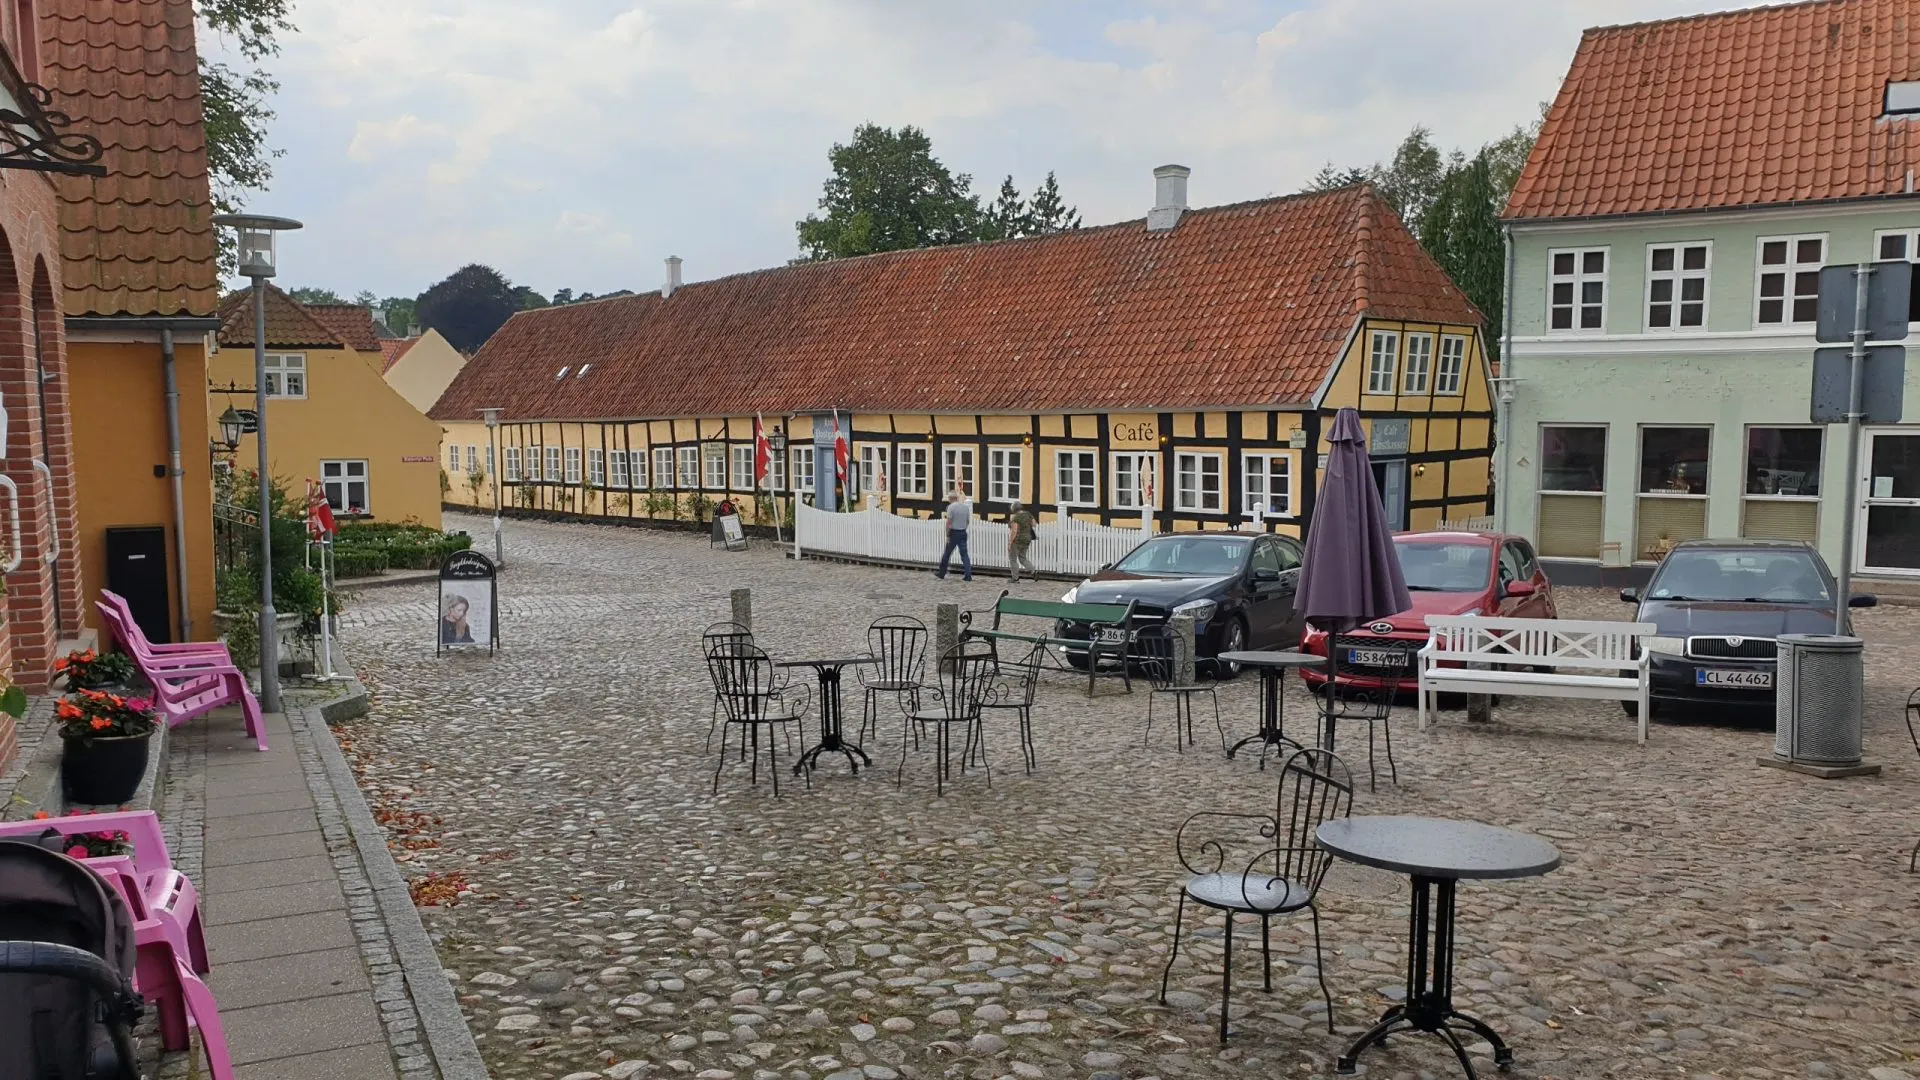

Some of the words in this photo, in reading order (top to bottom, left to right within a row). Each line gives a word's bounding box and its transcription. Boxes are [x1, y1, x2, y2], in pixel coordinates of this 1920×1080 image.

[1113, 422, 1154, 441] Café
[1107, 630, 1118, 640] 86
[1356, 652, 1370, 661] BS
[1706, 672, 1723, 683] CL
[1726, 673, 1742, 684] 44
[1745, 674, 1769, 685] 462
